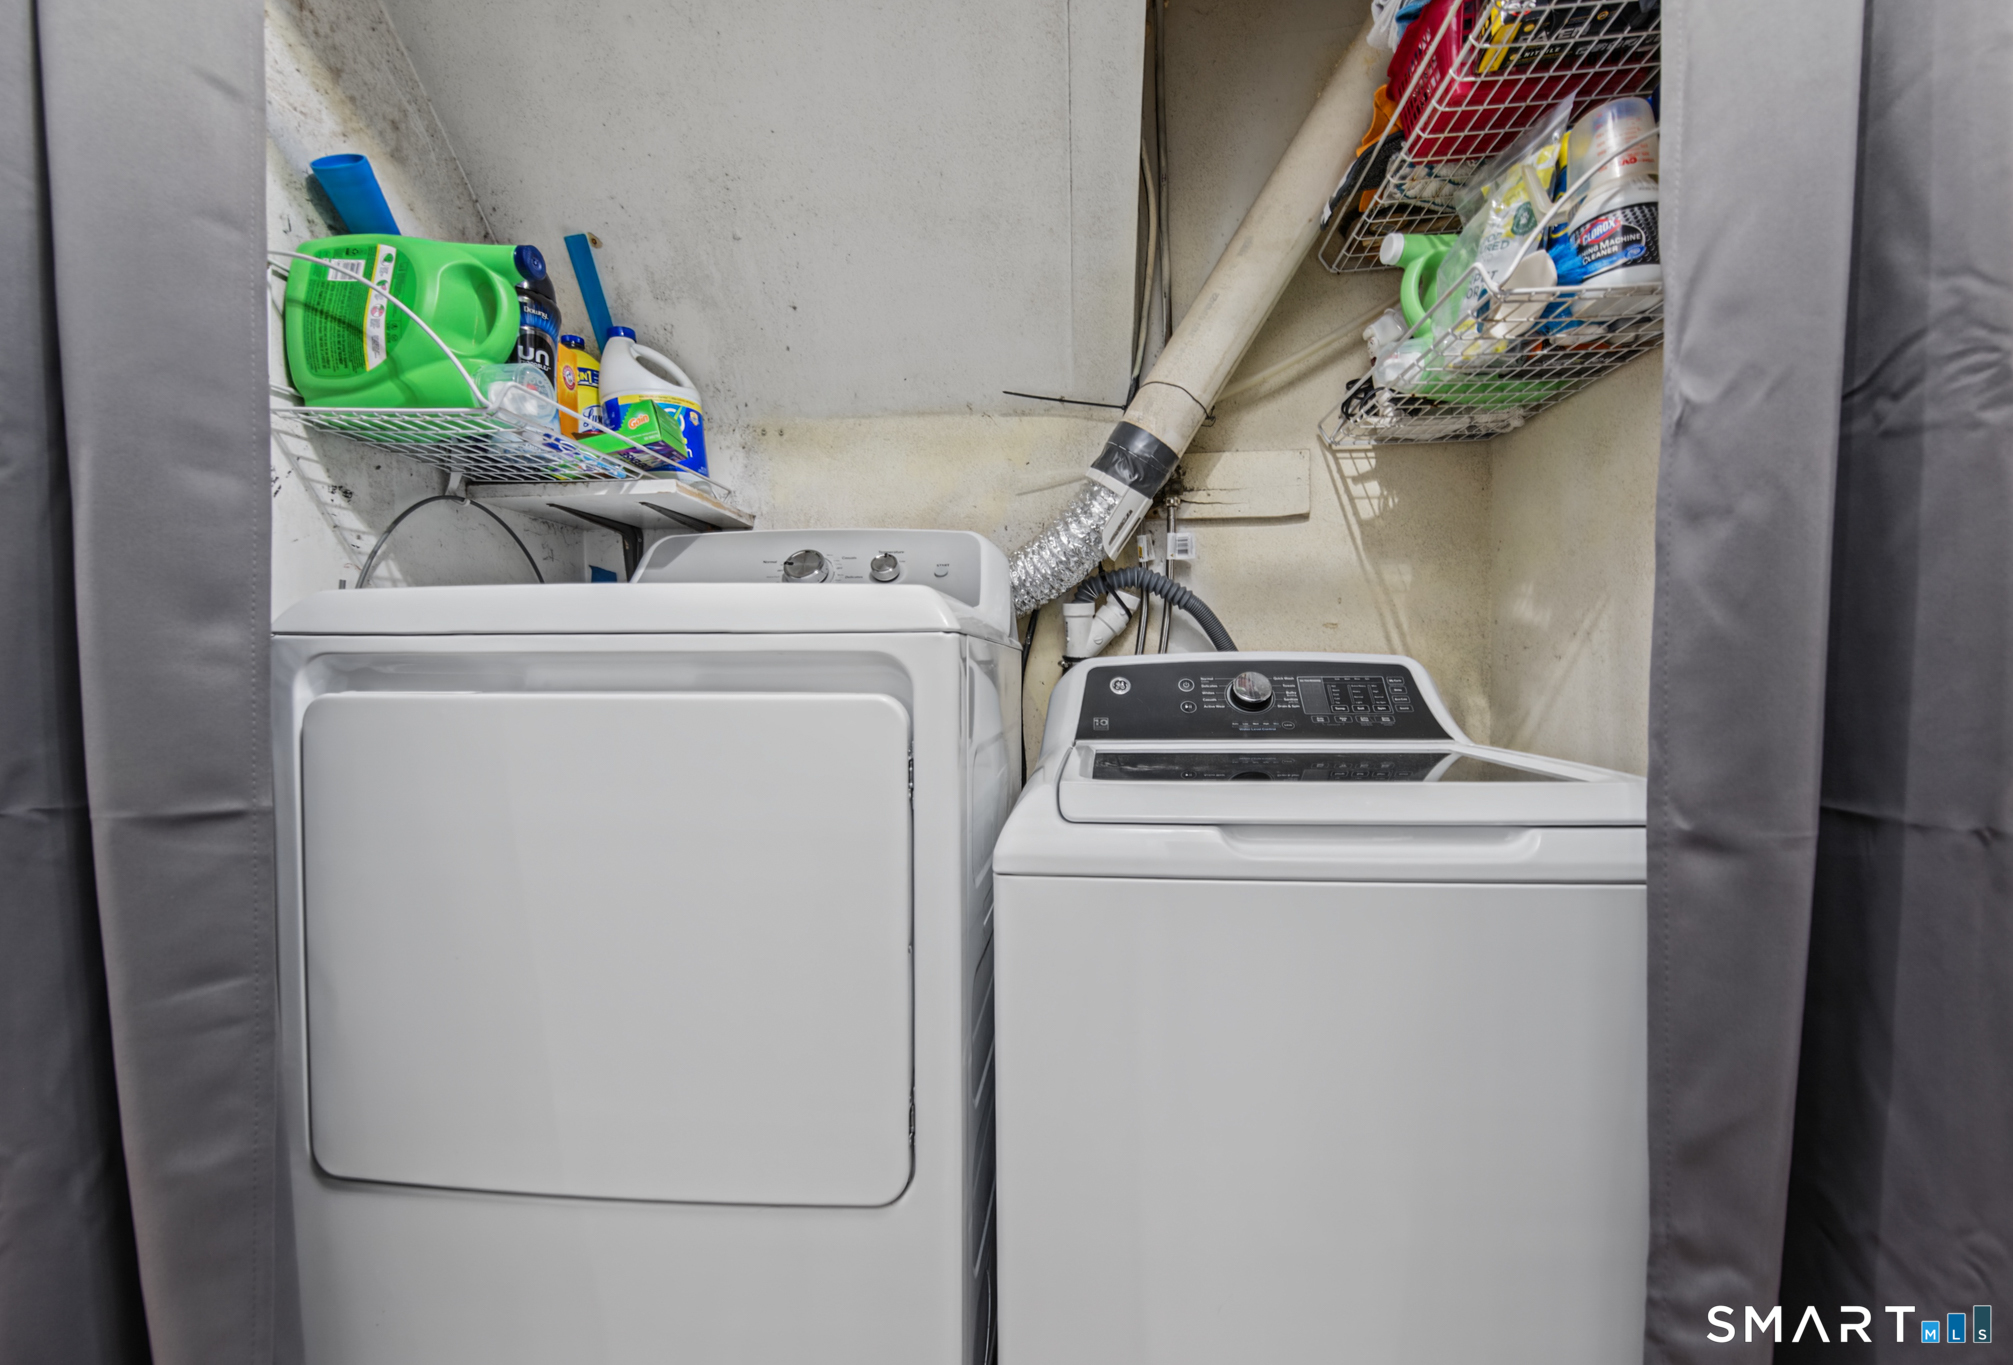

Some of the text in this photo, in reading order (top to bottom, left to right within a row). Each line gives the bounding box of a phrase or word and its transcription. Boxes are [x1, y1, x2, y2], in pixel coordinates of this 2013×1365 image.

[1518, 24, 1591, 45] RAEN
[1523, 46, 1561, 58] NITILE
[1582, 216, 1617, 246] CLOROX
[1600, 232, 1641, 252] MACHINE
[1582, 245, 1619, 266] CLEANER
[523, 304, 549, 320] Downy
[628, 413, 650, 430] Gain
